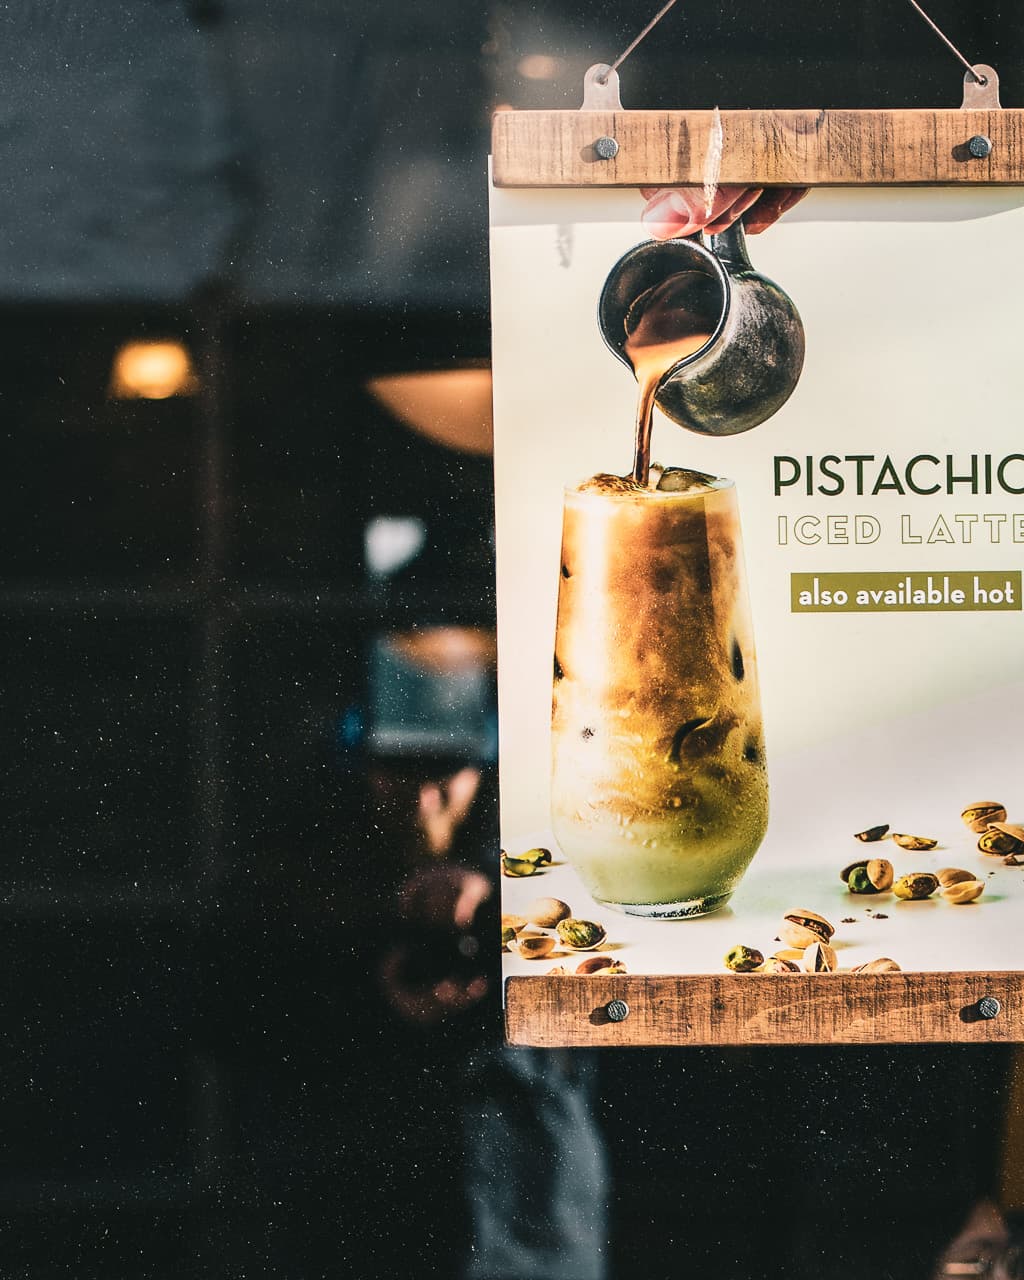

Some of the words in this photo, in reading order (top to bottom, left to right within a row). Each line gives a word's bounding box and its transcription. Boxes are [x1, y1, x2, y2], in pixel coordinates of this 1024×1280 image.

[777, 515, 882, 545] ICED
[798, 577, 848, 606] also
[855, 576, 966, 606] available
[973, 576, 1014, 605] hot
